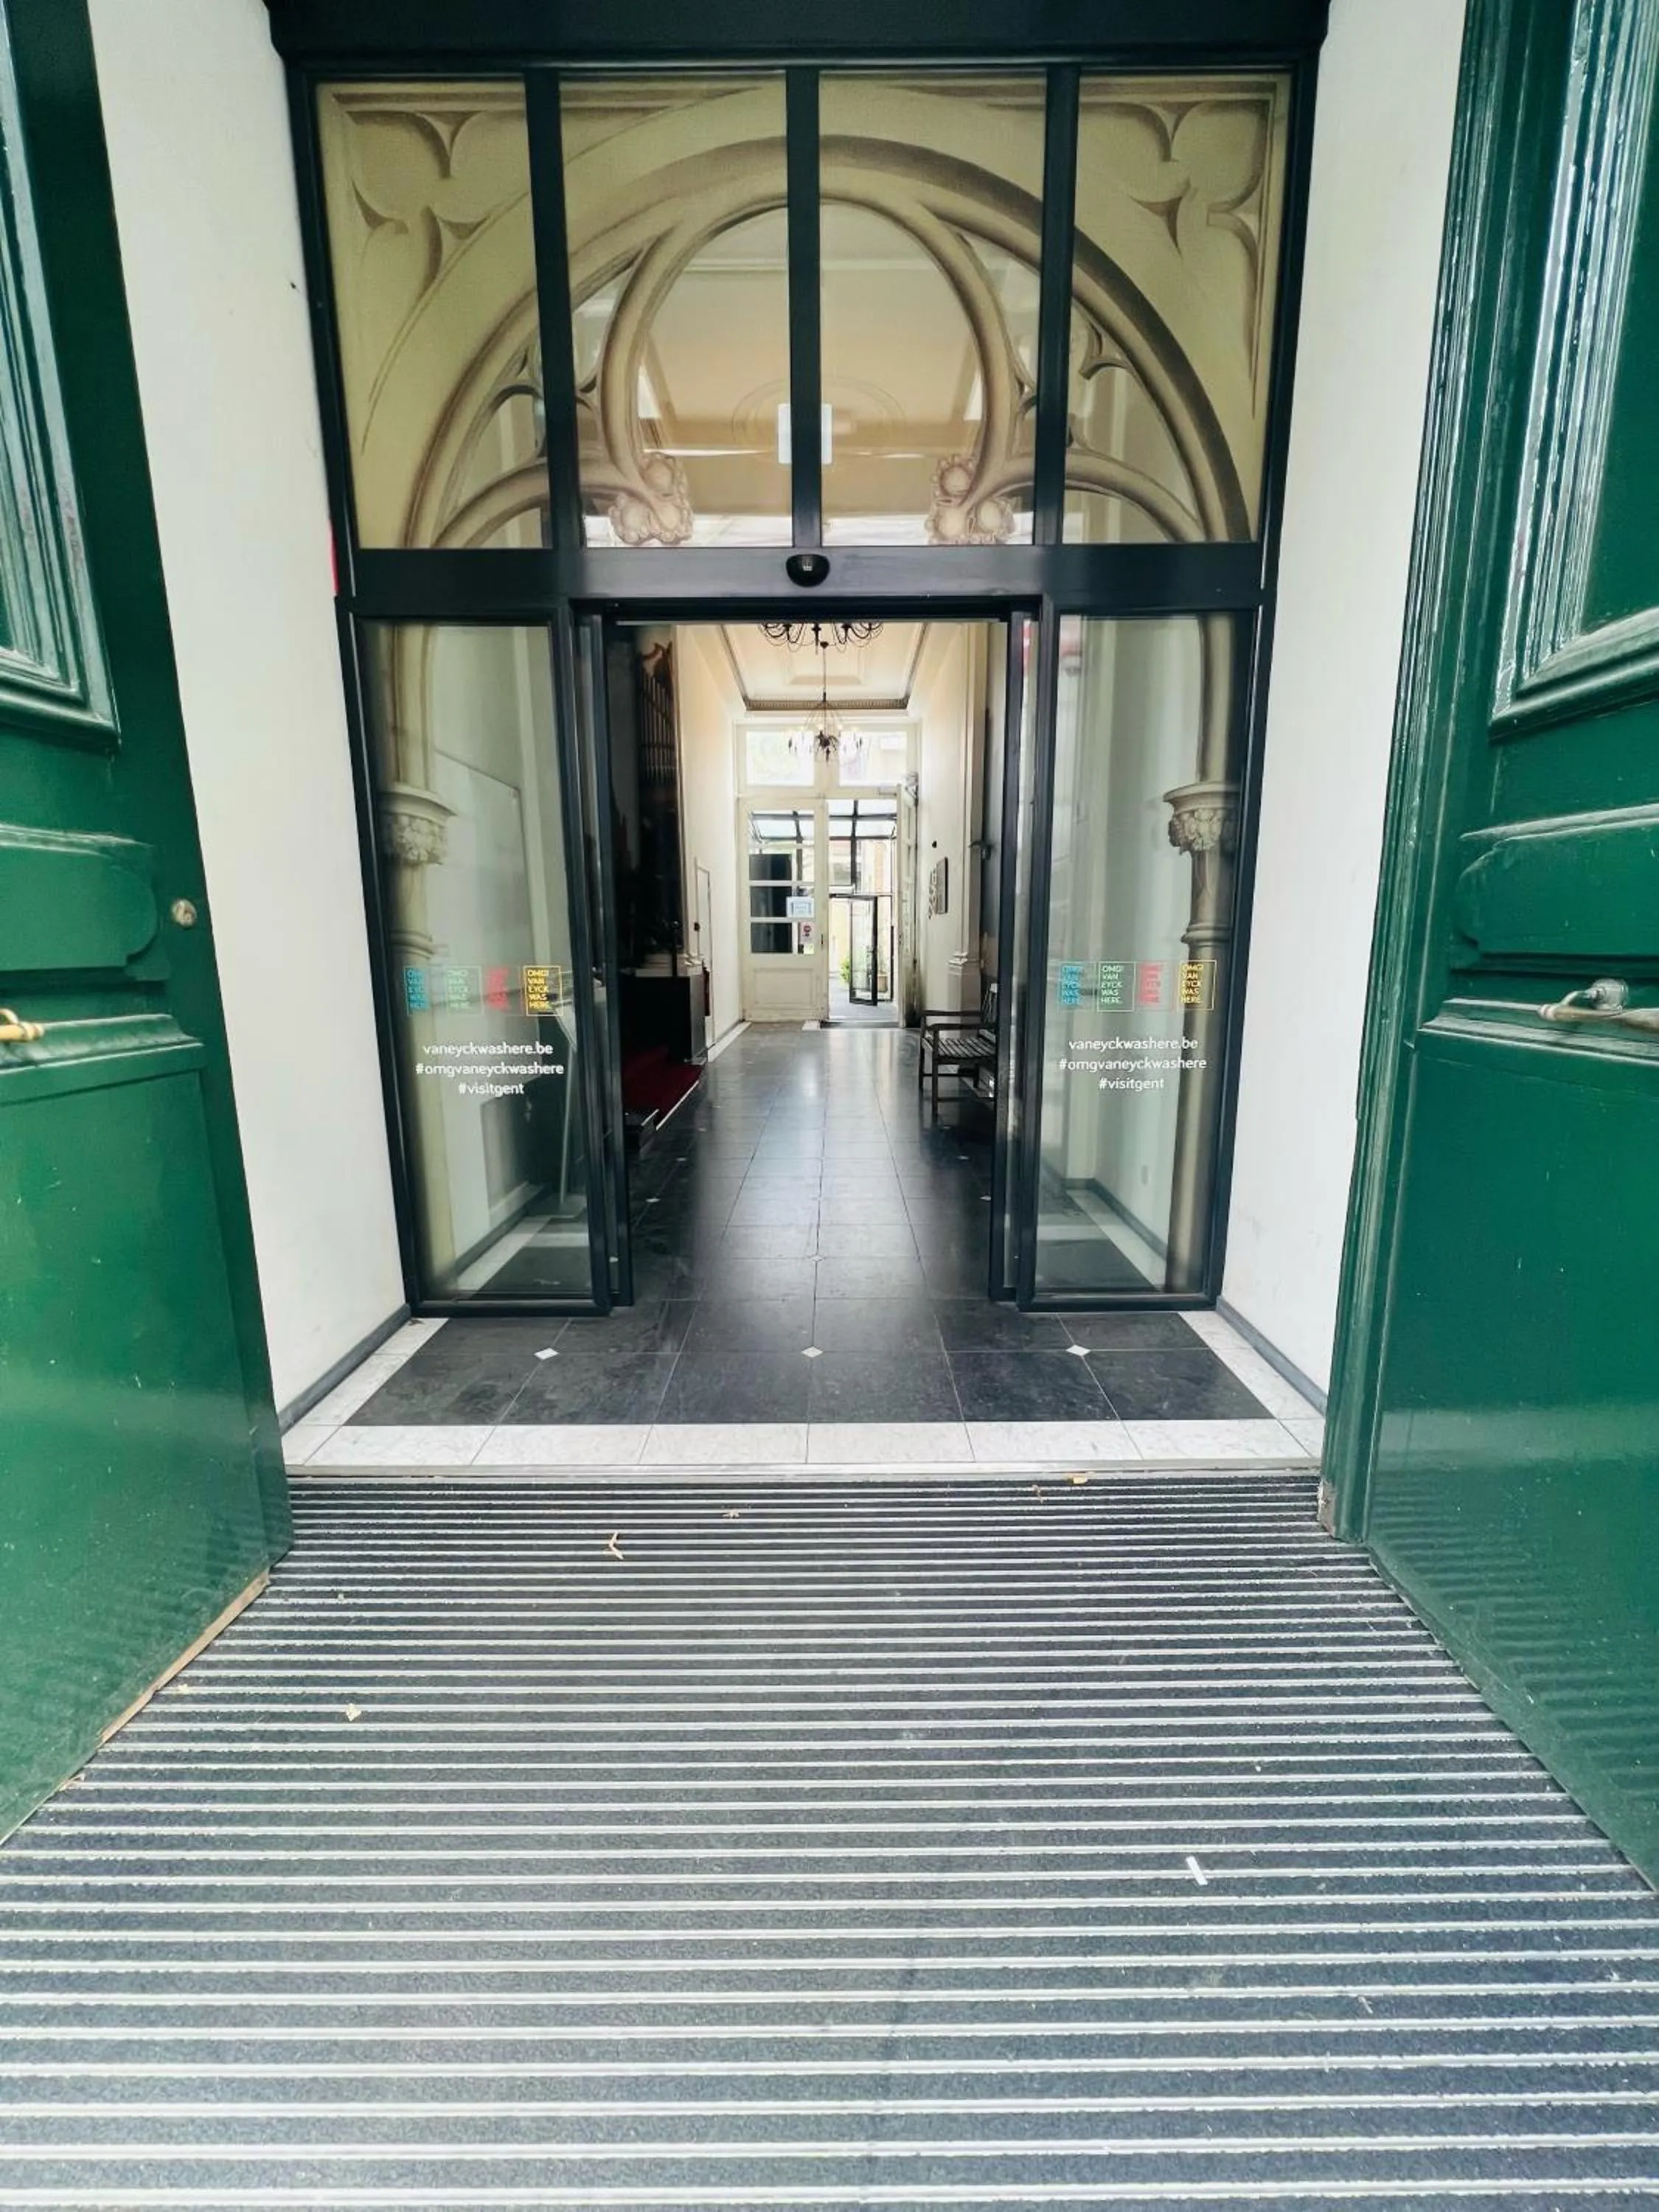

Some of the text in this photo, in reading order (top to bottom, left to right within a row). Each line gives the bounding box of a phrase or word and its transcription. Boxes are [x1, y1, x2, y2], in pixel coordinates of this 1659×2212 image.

[422, 1041, 553, 1057] vaneyckwashere.be
[1069, 1037, 1198, 1052] vaneyckwashere.be
[415, 1062, 564, 1077] #omgvaneyckwashere
[1060, 1057, 1207, 1072] #omgvaneyckwashere
[458, 1082, 524, 1097] #visitgent
[1099, 1077, 1164, 1091] #visitgent
